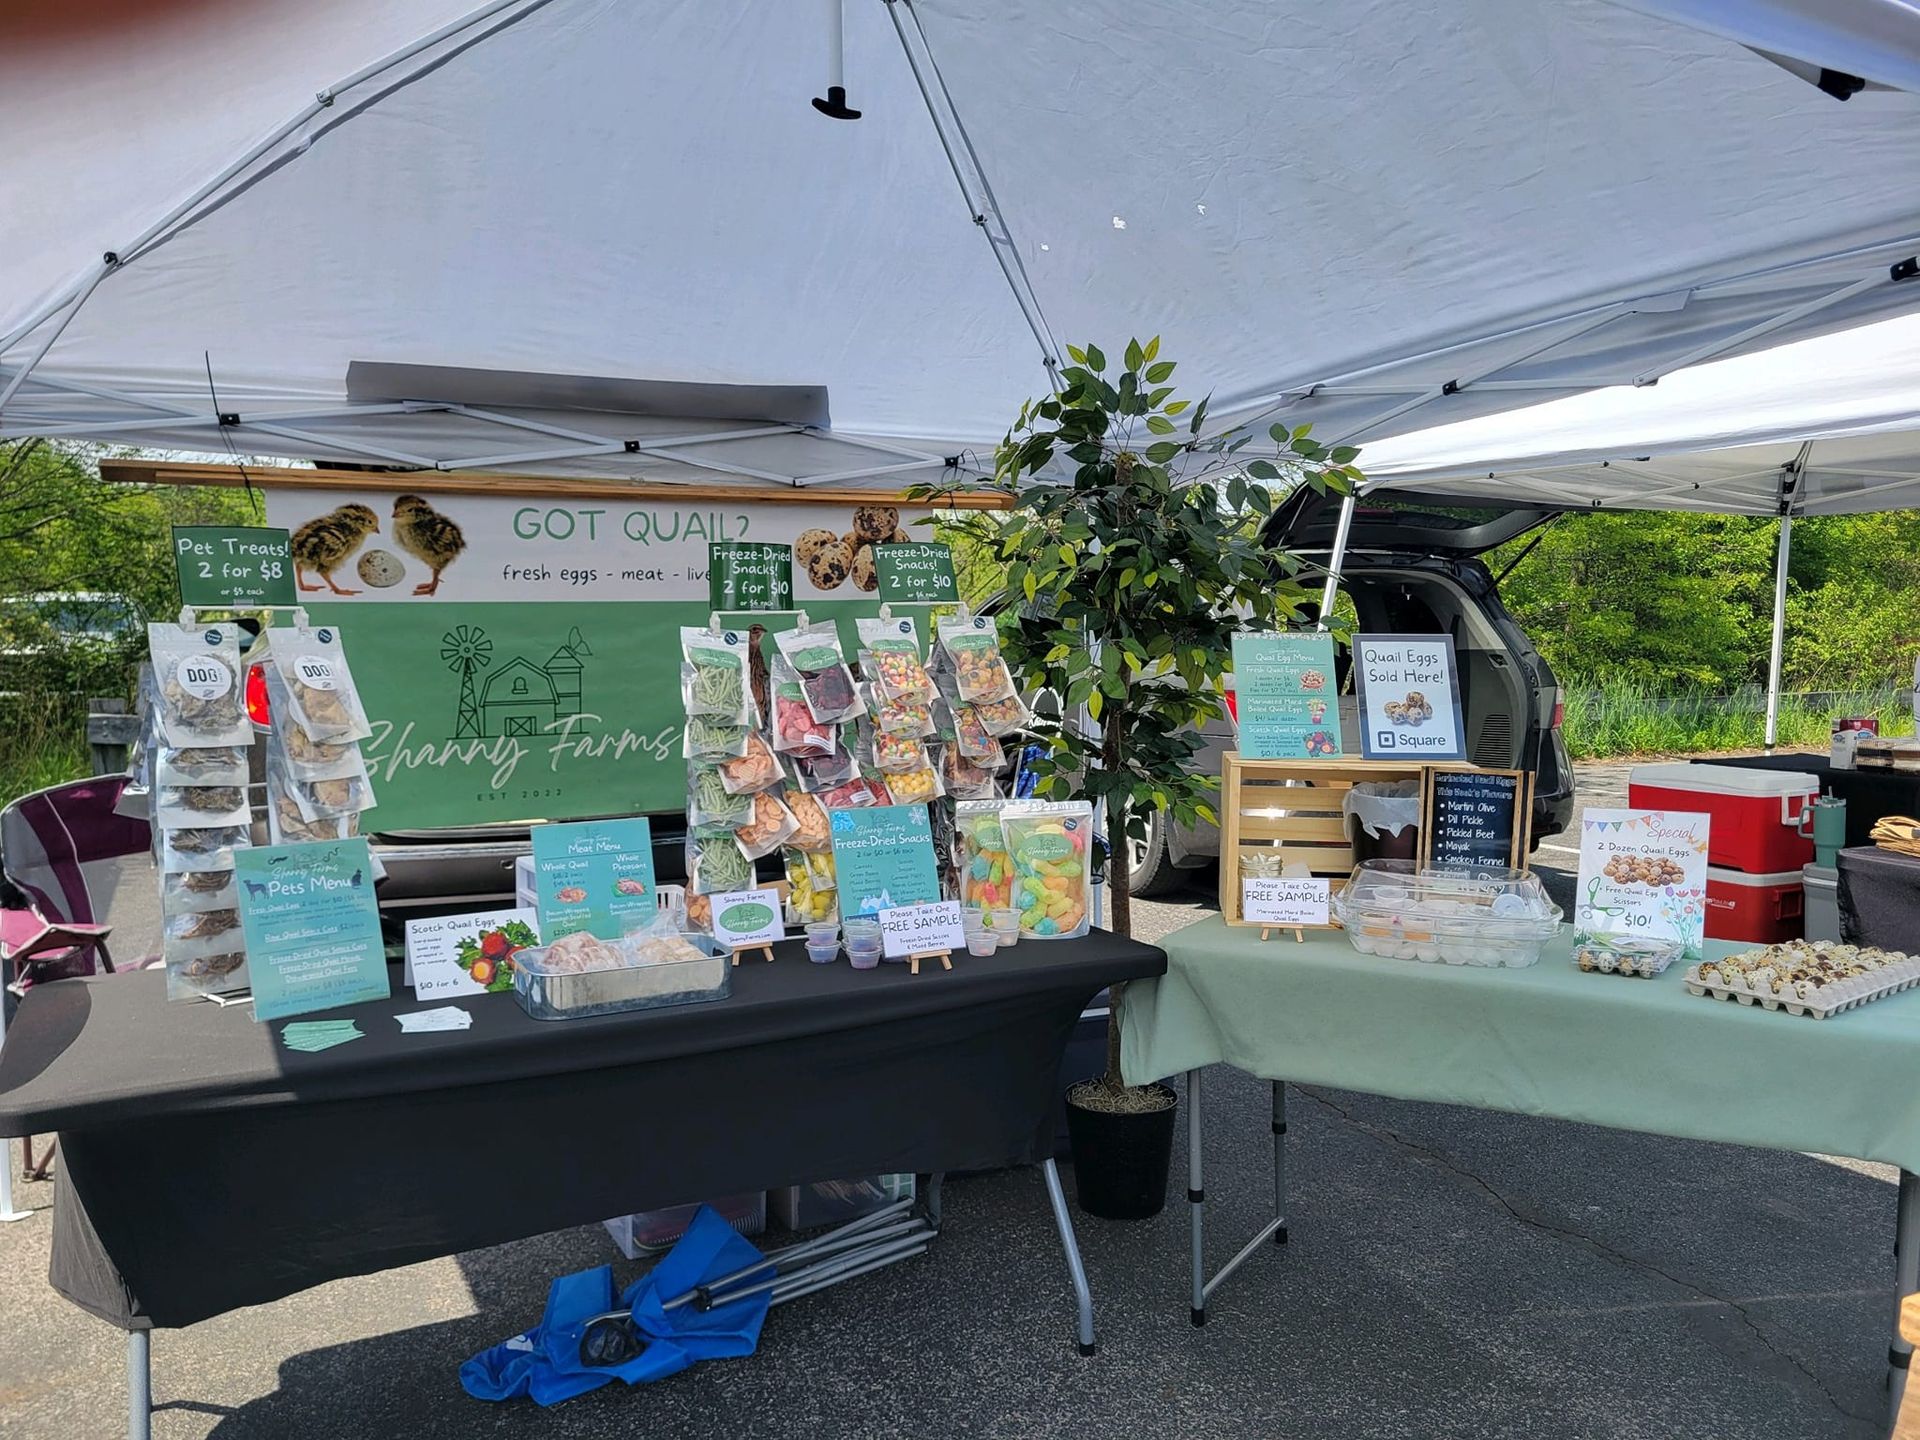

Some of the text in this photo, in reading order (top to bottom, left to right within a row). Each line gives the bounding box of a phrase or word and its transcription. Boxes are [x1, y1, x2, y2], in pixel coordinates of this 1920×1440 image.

[513, 508, 749, 546] GOT QUAIL?
[178, 538, 289, 558] Pet Treats!
[713, 546, 791, 561] Freeze-Dried
[875, 545, 950, 560] Freeze-Dried
[198, 560, 283, 581] 2 for $8
[732, 560, 779, 577] Snacks!
[895, 558, 938, 572] Snacks!
[503, 564, 551, 581] fresh
[560, 568, 597, 585] eggs
[621, 567, 664, 581] meat
[890, 572, 952, 589] 2 for $10
[233, 587, 243, 596] $5
[723, 579, 789, 597] 2 for $10
[1256, 653, 1314, 663] Quail Egg Menu
[1365, 649, 1439, 667] Quail Eggs
[1369, 669, 1443, 684] Sold Here!
[1399, 734, 1446, 748] Square
[362, 713, 682, 790] Shanny Farms
[478, 788, 562, 801] EST 2022
[1448, 801, 1496, 813] Martini Olive
[1462, 815, 1484, 825] Pickle
[1446, 828, 1495, 839] Pickled Beet
[1647, 820, 1696, 843] Special
[568, 841, 621, 854] Meat Menu
[834, 833, 930, 850] Freeze-Dried Snacks
[1446, 841, 1471, 853] Mayak
[1598, 842, 1690, 858] 2 Dozen Quail Eggs
[616, 854, 640, 862] Whole
[1478, 855, 1505, 866] Fennel
[541, 861, 589, 871] Whole Quail
[268, 876, 352, 898] Pets Menu
[1605, 885, 1658, 899] Free Quail Egg
[724, 896, 746, 904] Shanny
[1245, 891, 1328, 904] FREE SAMPLE!
[1613, 896, 1642, 907] Scissors
[915, 907, 933, 915] Take
[411, 918, 496, 934] Scotch Quail Eggs
[881, 914, 962, 934] FREE SAMPLE!
[1624, 914, 1652, 929] $10!
[420, 982, 433, 990] $10
